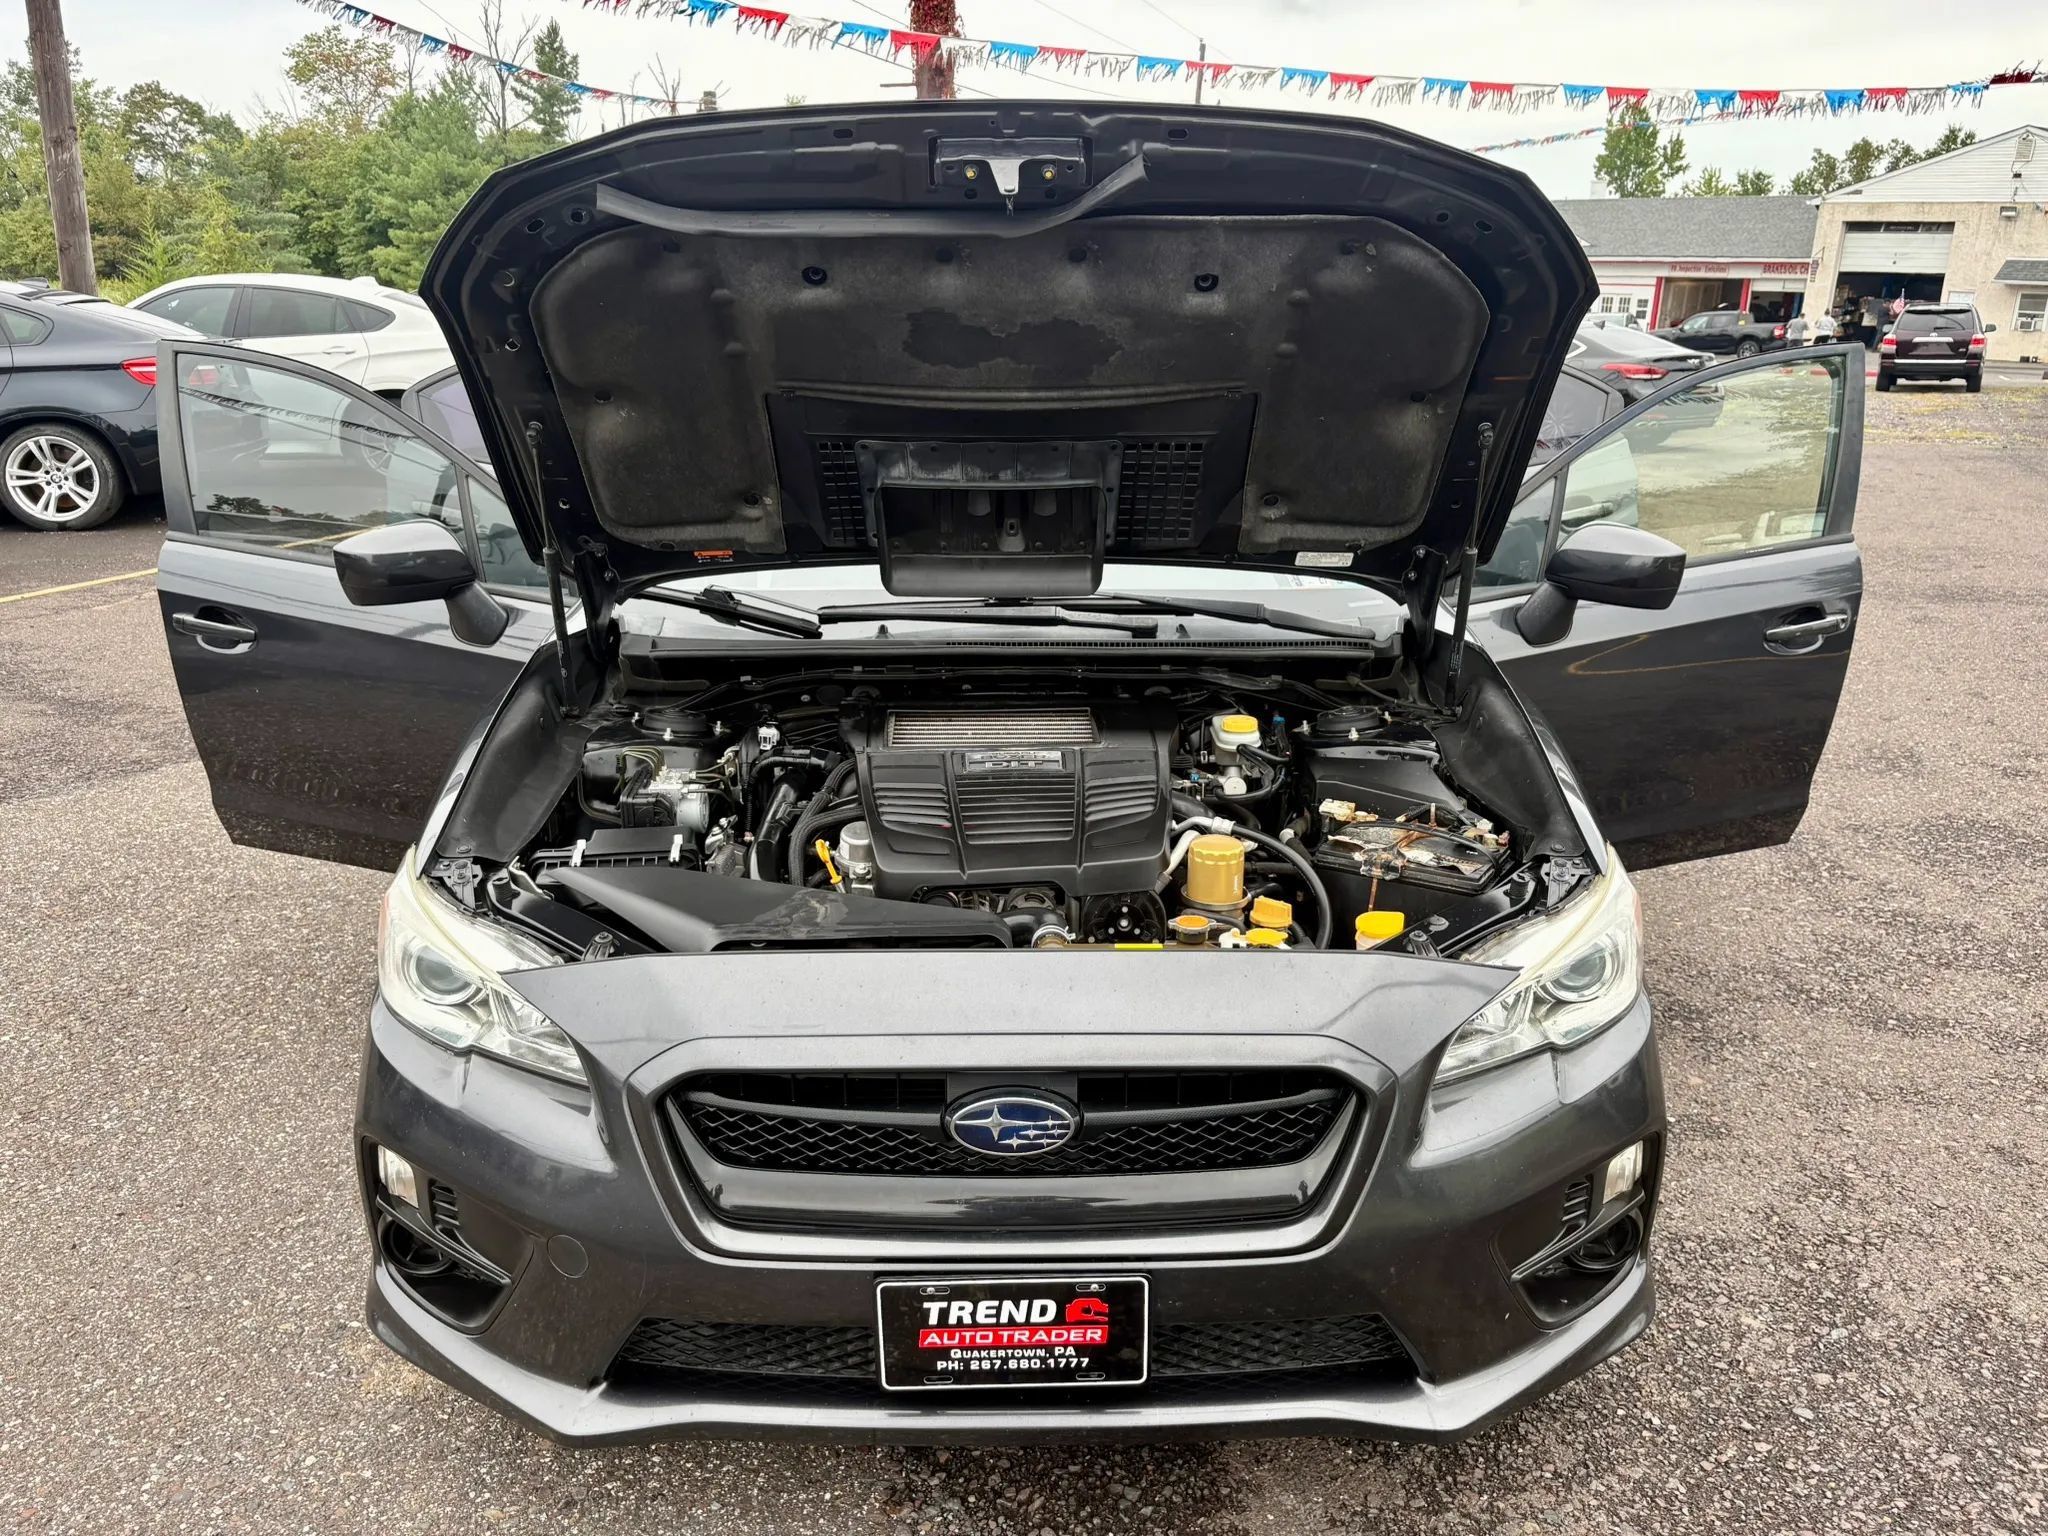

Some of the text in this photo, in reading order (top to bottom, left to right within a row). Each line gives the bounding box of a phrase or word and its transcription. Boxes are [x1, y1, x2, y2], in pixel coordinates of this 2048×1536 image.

[922, 1298, 1057, 1325] TREND
[923, 1328, 1103, 1345] AUTO TRADER
[1055, 1346, 1076, 1356] PA
[936, 1357, 1089, 1371] PH: 267.680.1777
